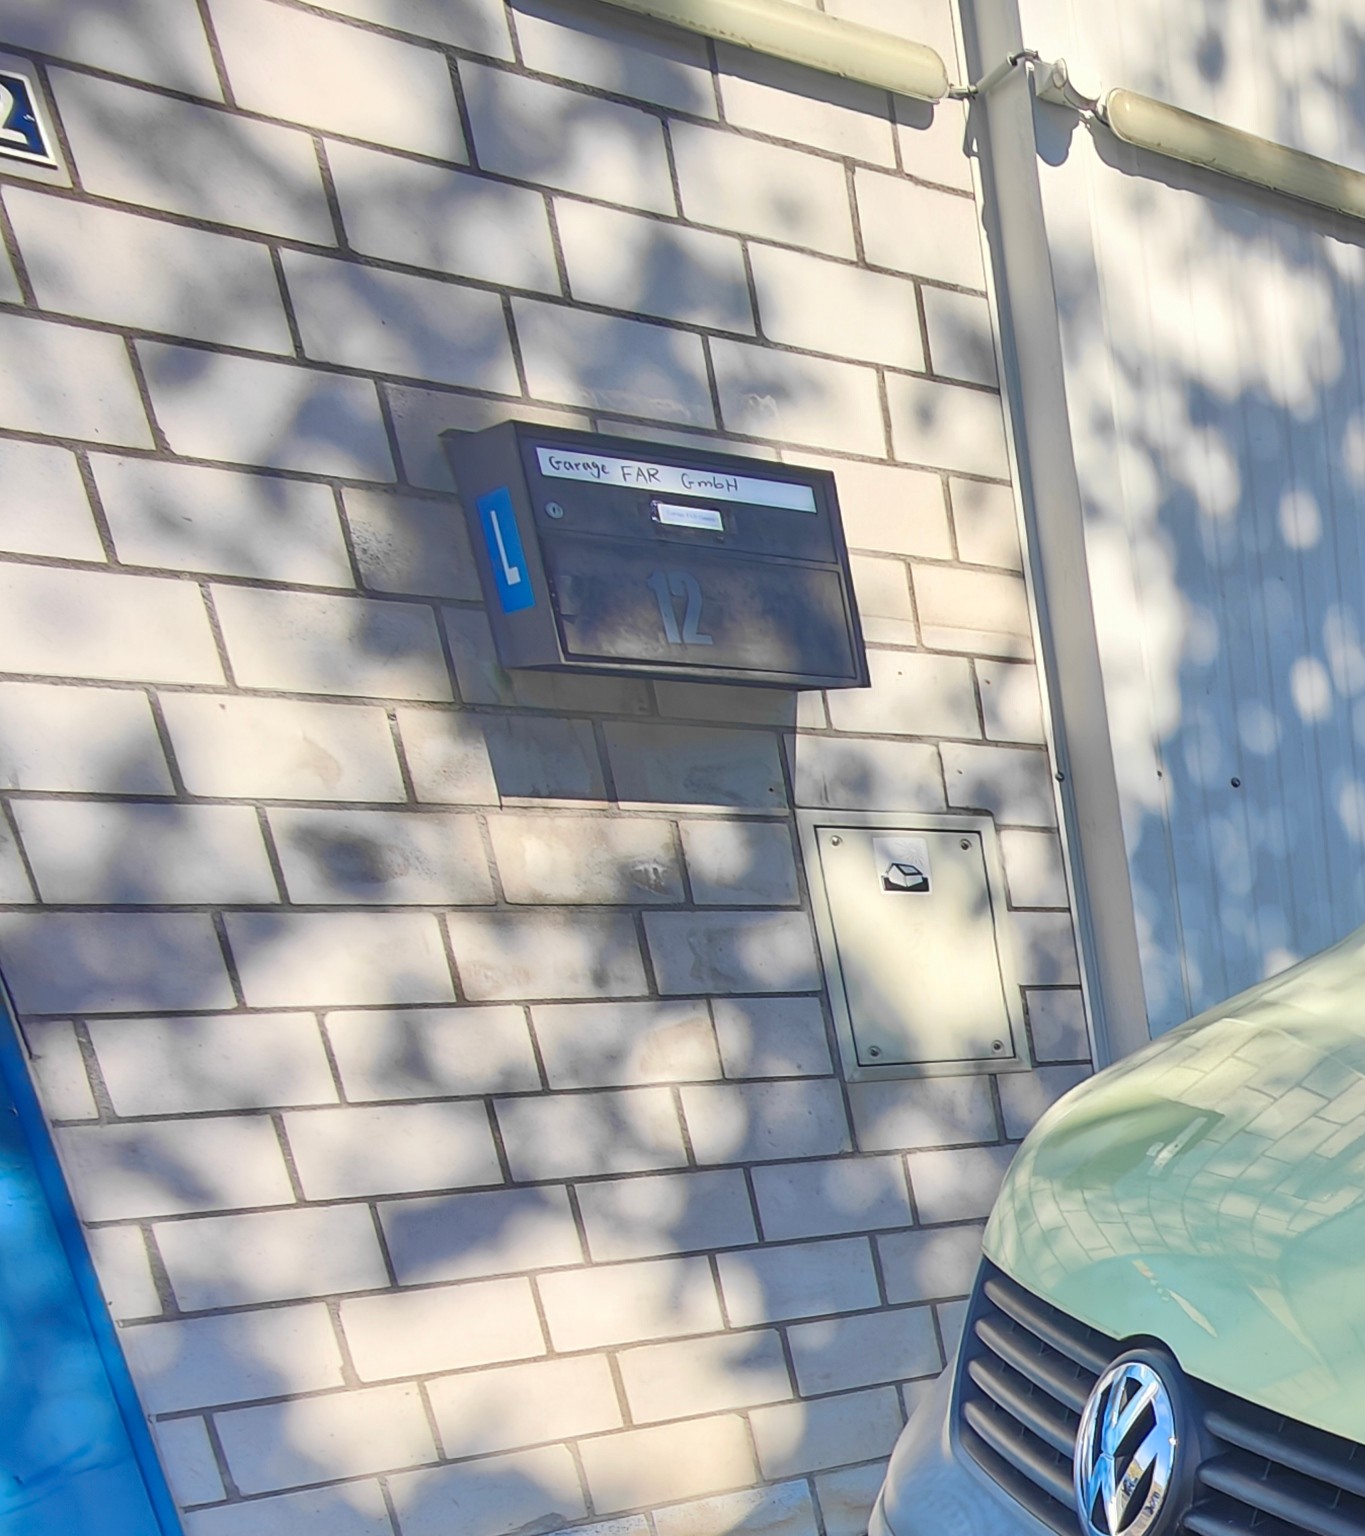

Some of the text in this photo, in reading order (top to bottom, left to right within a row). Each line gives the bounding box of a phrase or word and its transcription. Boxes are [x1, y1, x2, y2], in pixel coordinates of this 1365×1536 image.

[549, 456, 739, 492] Garage FAR GmbH
[647, 569, 714, 647] 12
